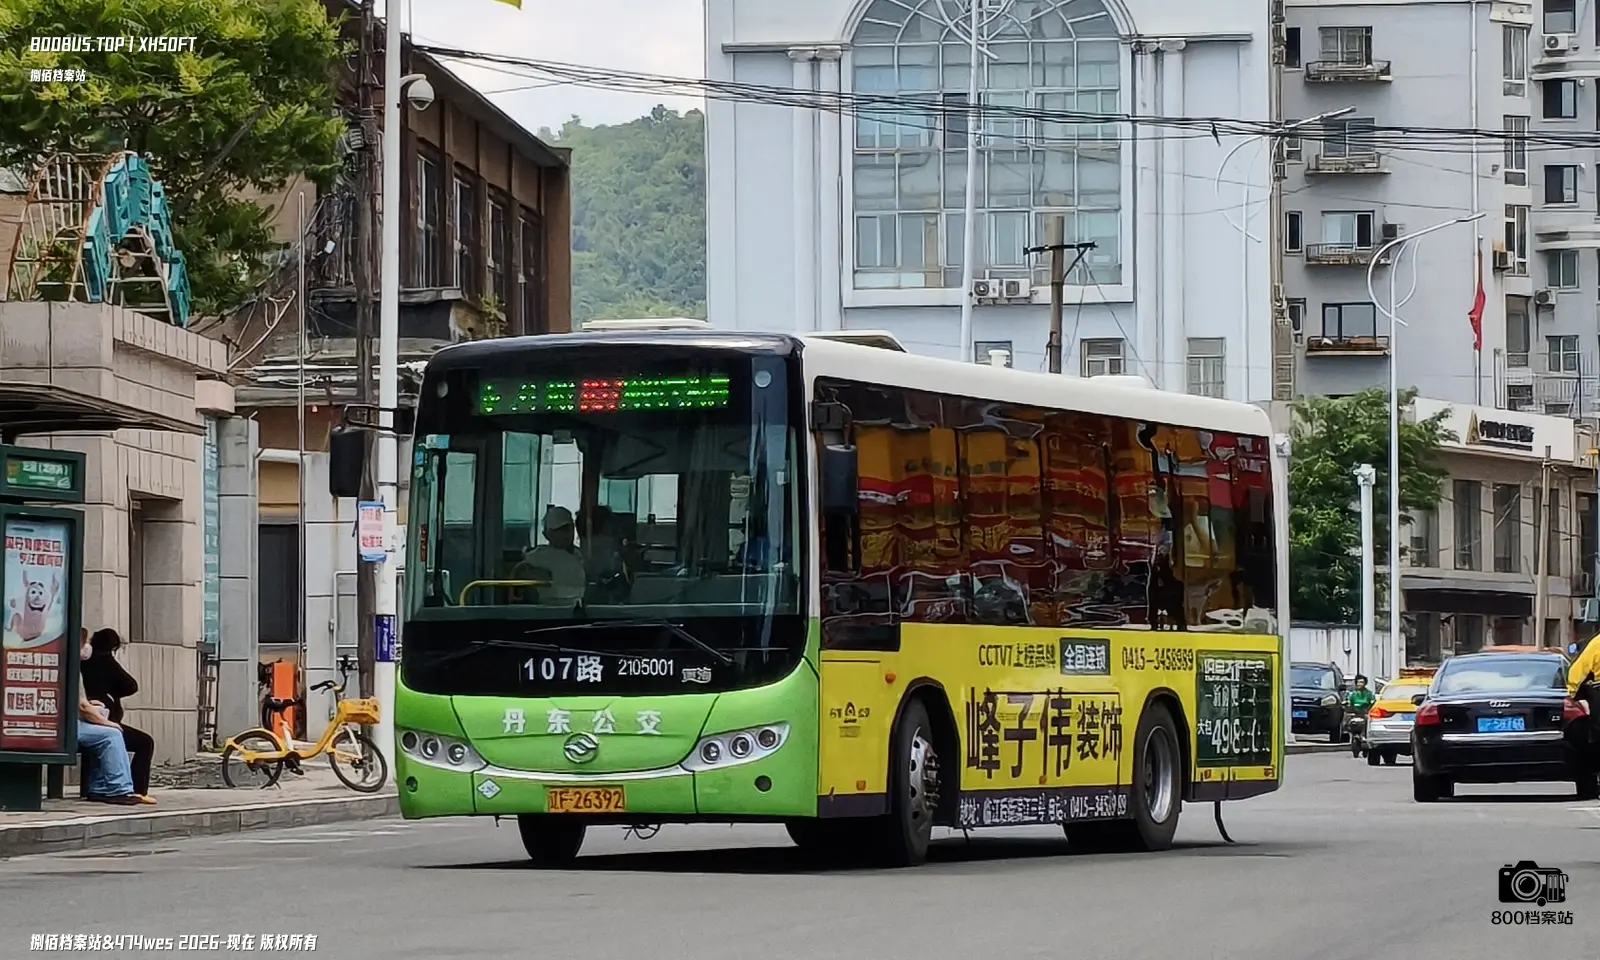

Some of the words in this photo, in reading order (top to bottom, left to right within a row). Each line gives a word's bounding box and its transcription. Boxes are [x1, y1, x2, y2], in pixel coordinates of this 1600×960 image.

[523, 655, 604, 683] 107路
[618, 658, 674, 676] 2105001
[1064, 643, 1106, 670] 全国连锁
[502, 708, 663, 736] 丹东公交
[966, 686, 1123, 779] 峰子伟装饰
